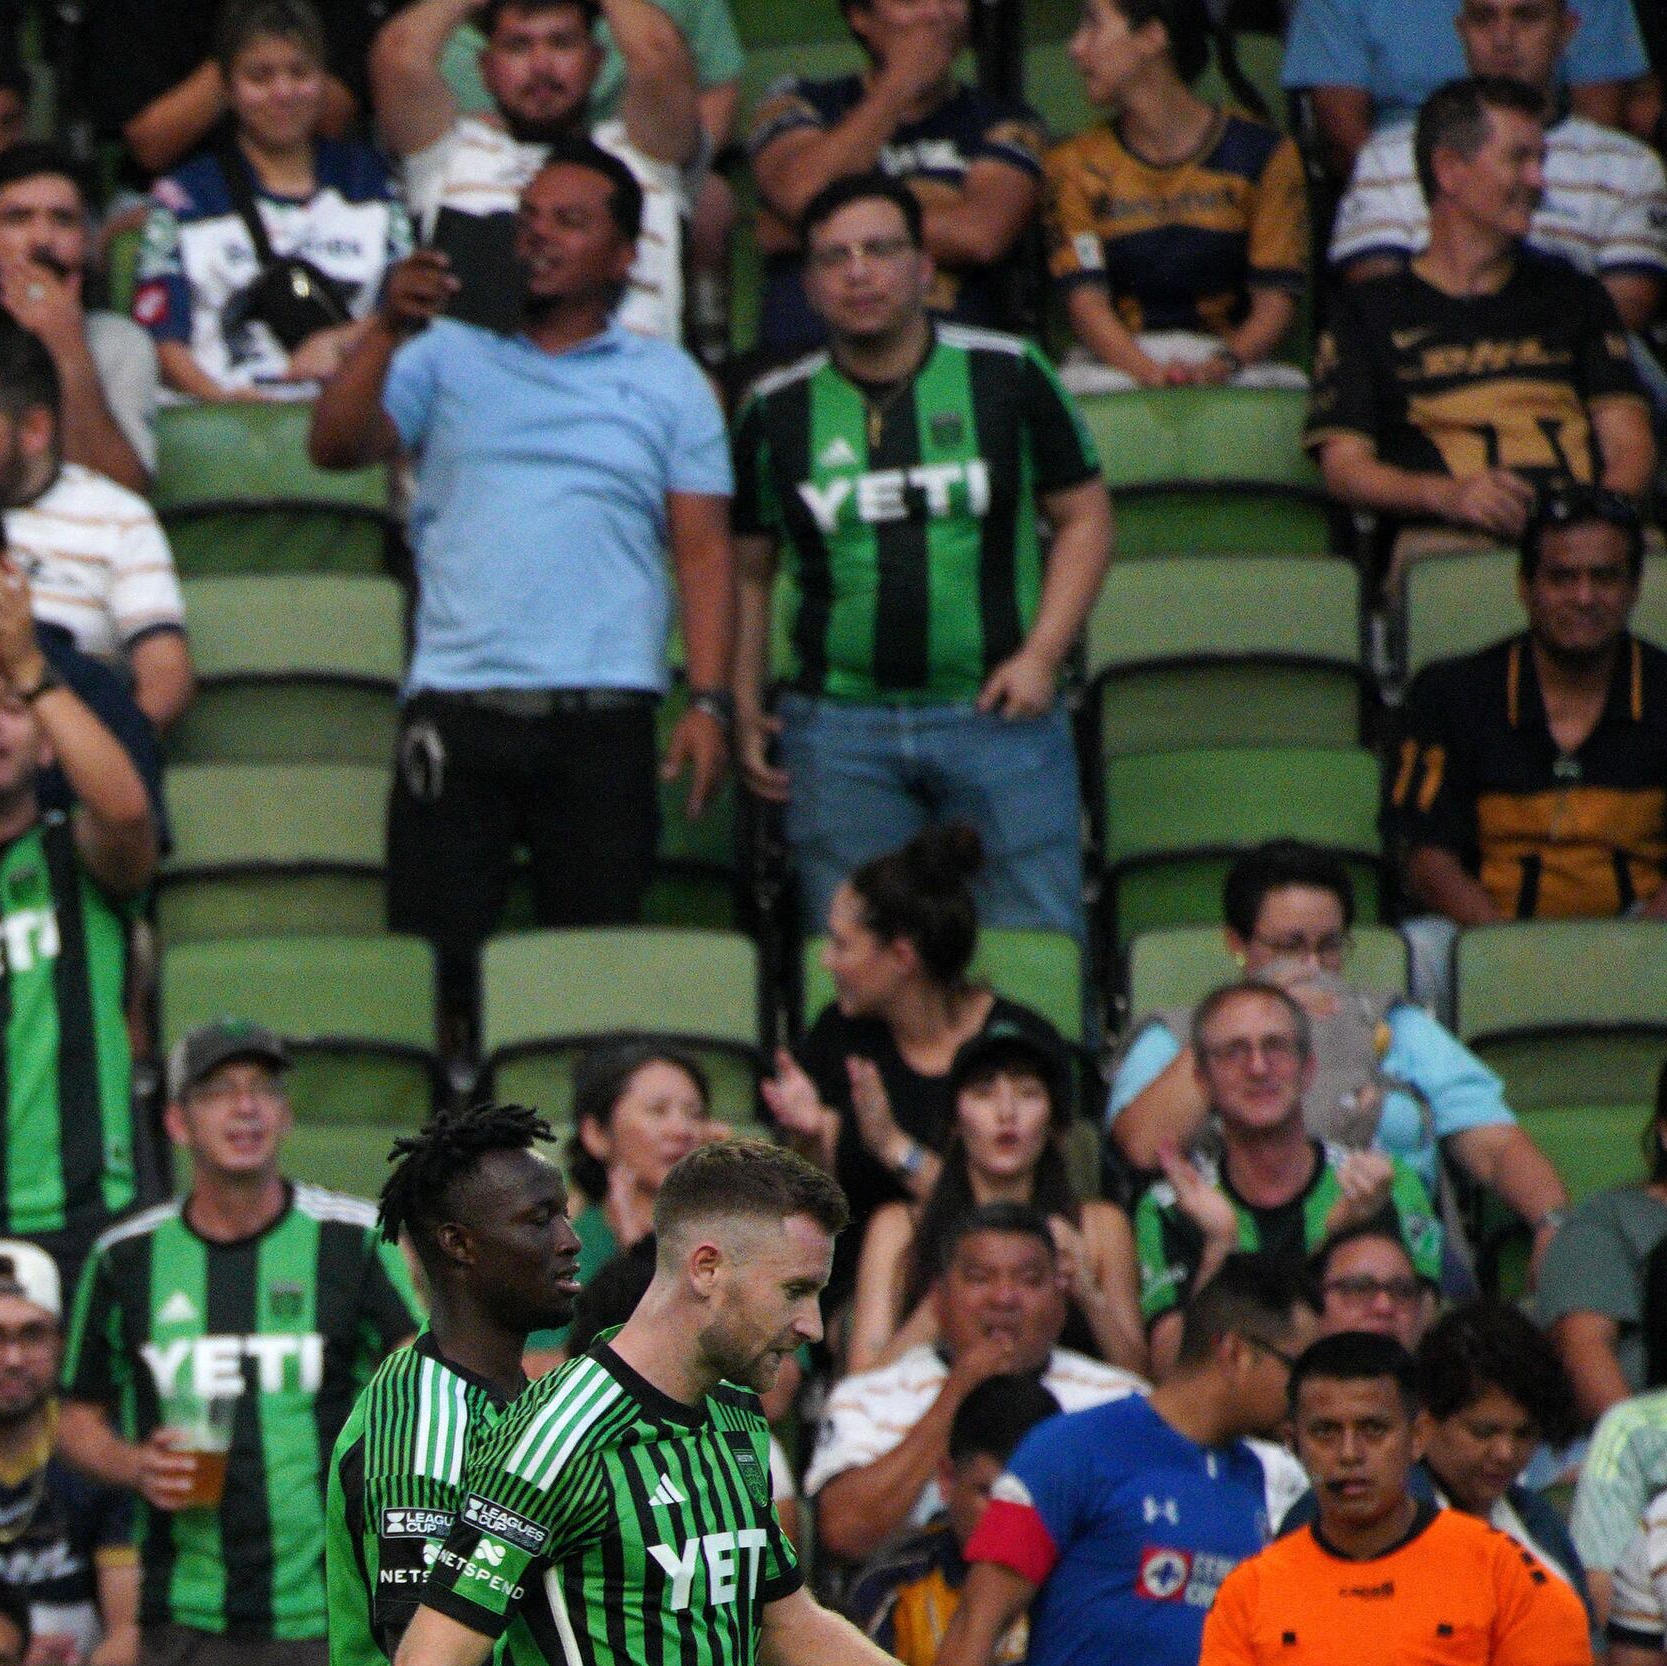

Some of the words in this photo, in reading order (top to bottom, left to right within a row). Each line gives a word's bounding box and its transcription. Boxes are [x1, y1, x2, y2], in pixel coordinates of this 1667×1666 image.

[798, 461, 990, 532] YETI
[142, 1334, 324, 1398] YETI
[405, 1523, 436, 1534] CUP
[406, 1511, 455, 1527] LEAGU
[477, 1515, 508, 1532] CUP
[480, 1506, 546, 1543] LEAGUES
[380, 1569, 432, 1584] NETS
[438, 1550, 525, 1600] NETSPEND
[647, 1528, 767, 1613] YET
